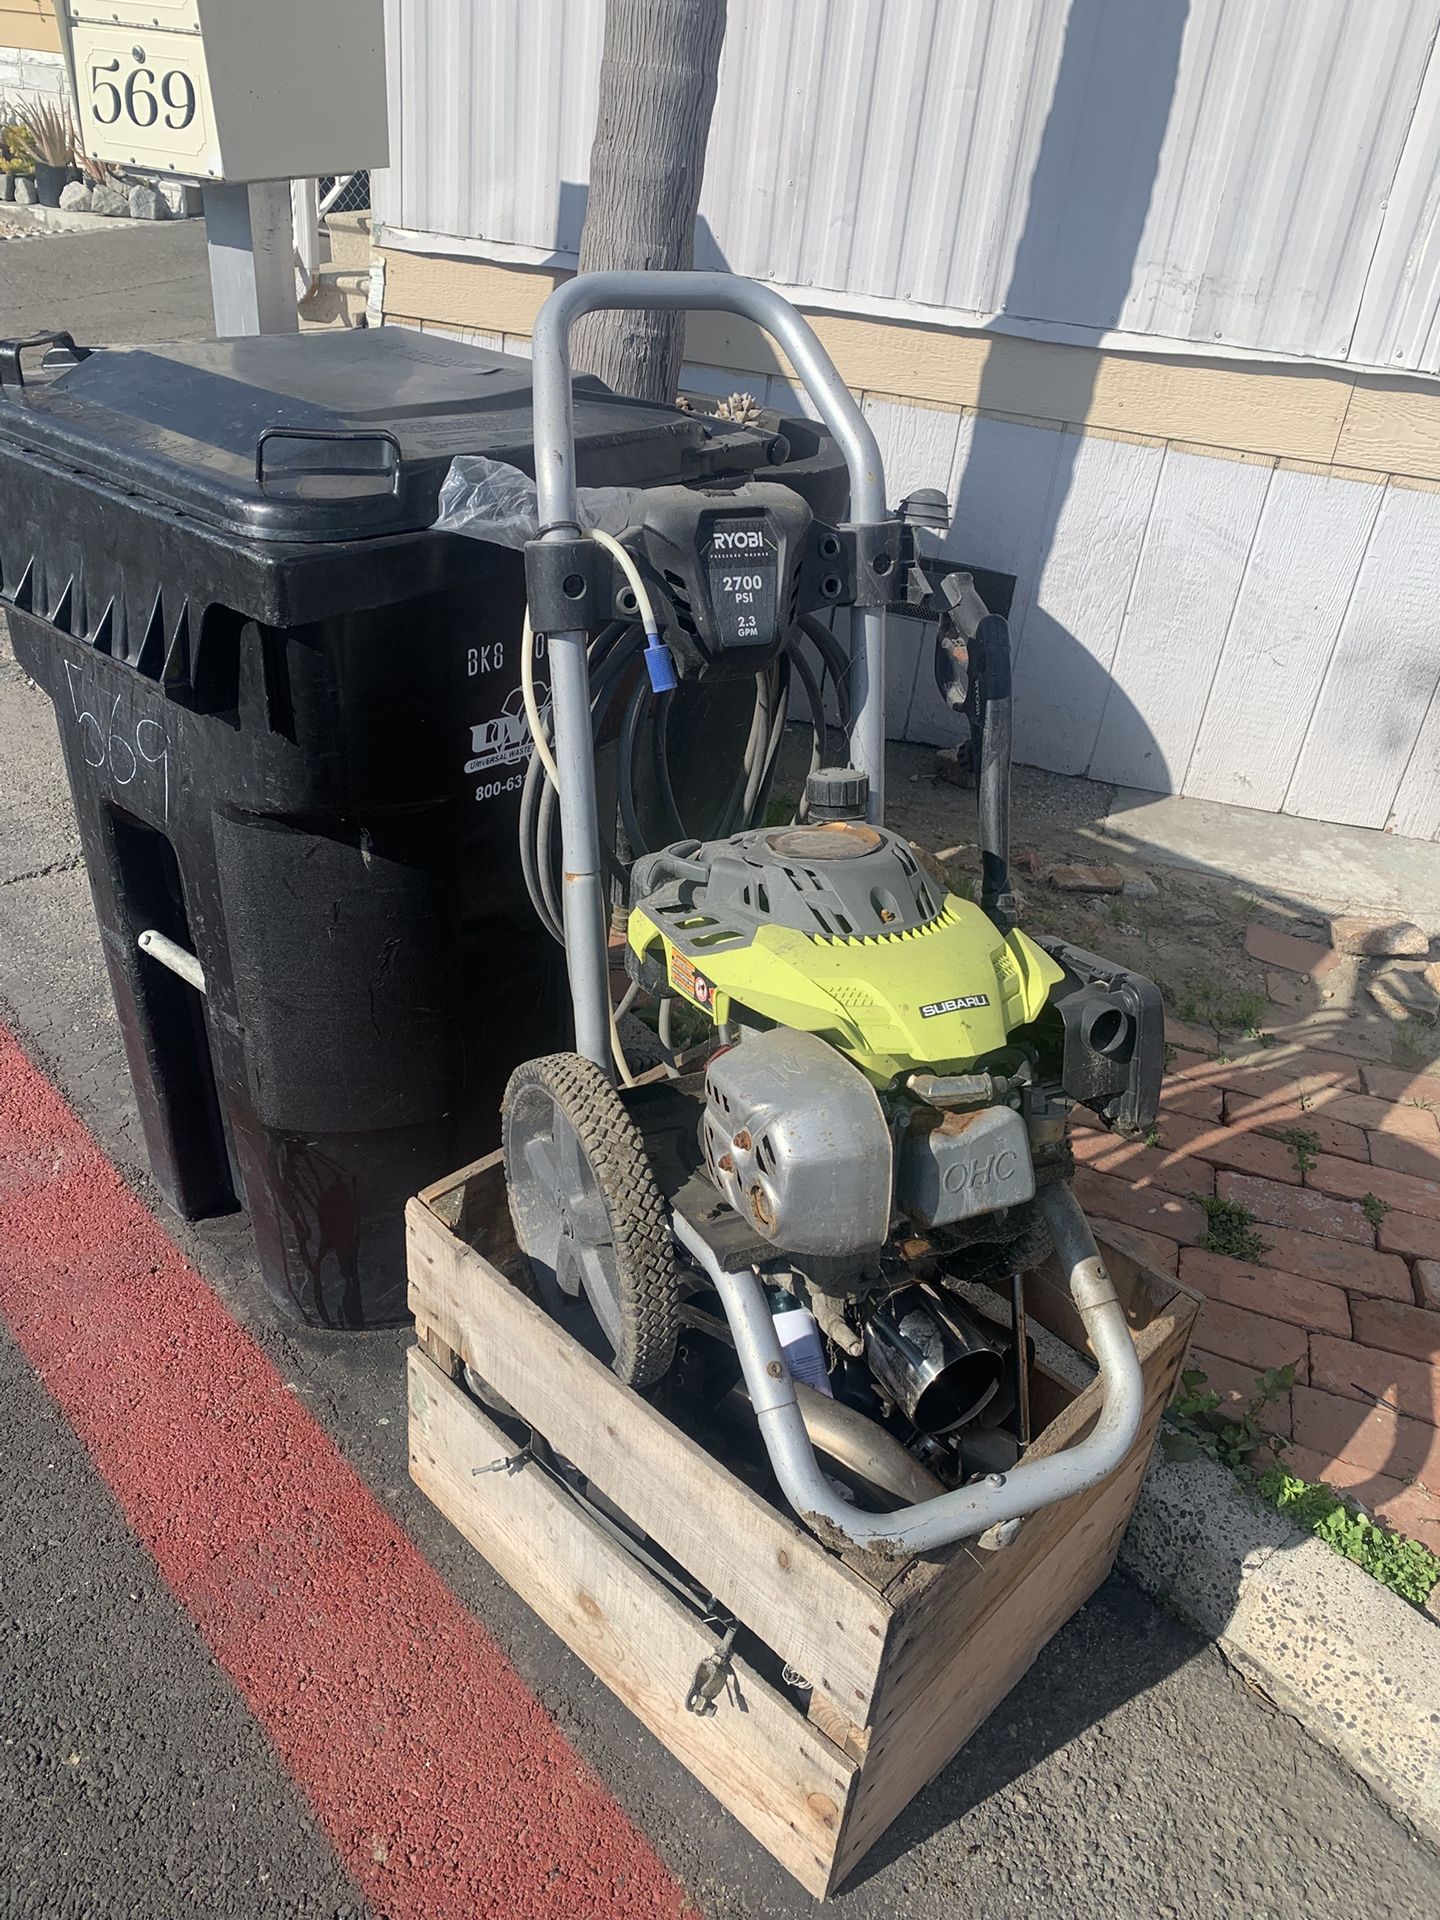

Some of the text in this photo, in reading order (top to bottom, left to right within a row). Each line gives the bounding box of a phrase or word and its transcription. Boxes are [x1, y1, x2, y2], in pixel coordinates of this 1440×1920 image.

[92, 58, 196, 129] 569
[713, 532, 763, 549] RYOBI
[722, 575, 762, 591] 2700
[735, 592, 753, 603] PSI
[738, 616, 756, 627] 2.3
[738, 628, 758, 637] GPM
[467, 642, 504, 676] BK8
[64, 659, 171, 823] 569
[469, 745, 533, 770] UNIVERSAL WASTE
[922, 995, 988, 1018] SUBARU
[943, 1150, 1018, 1193] OHC
